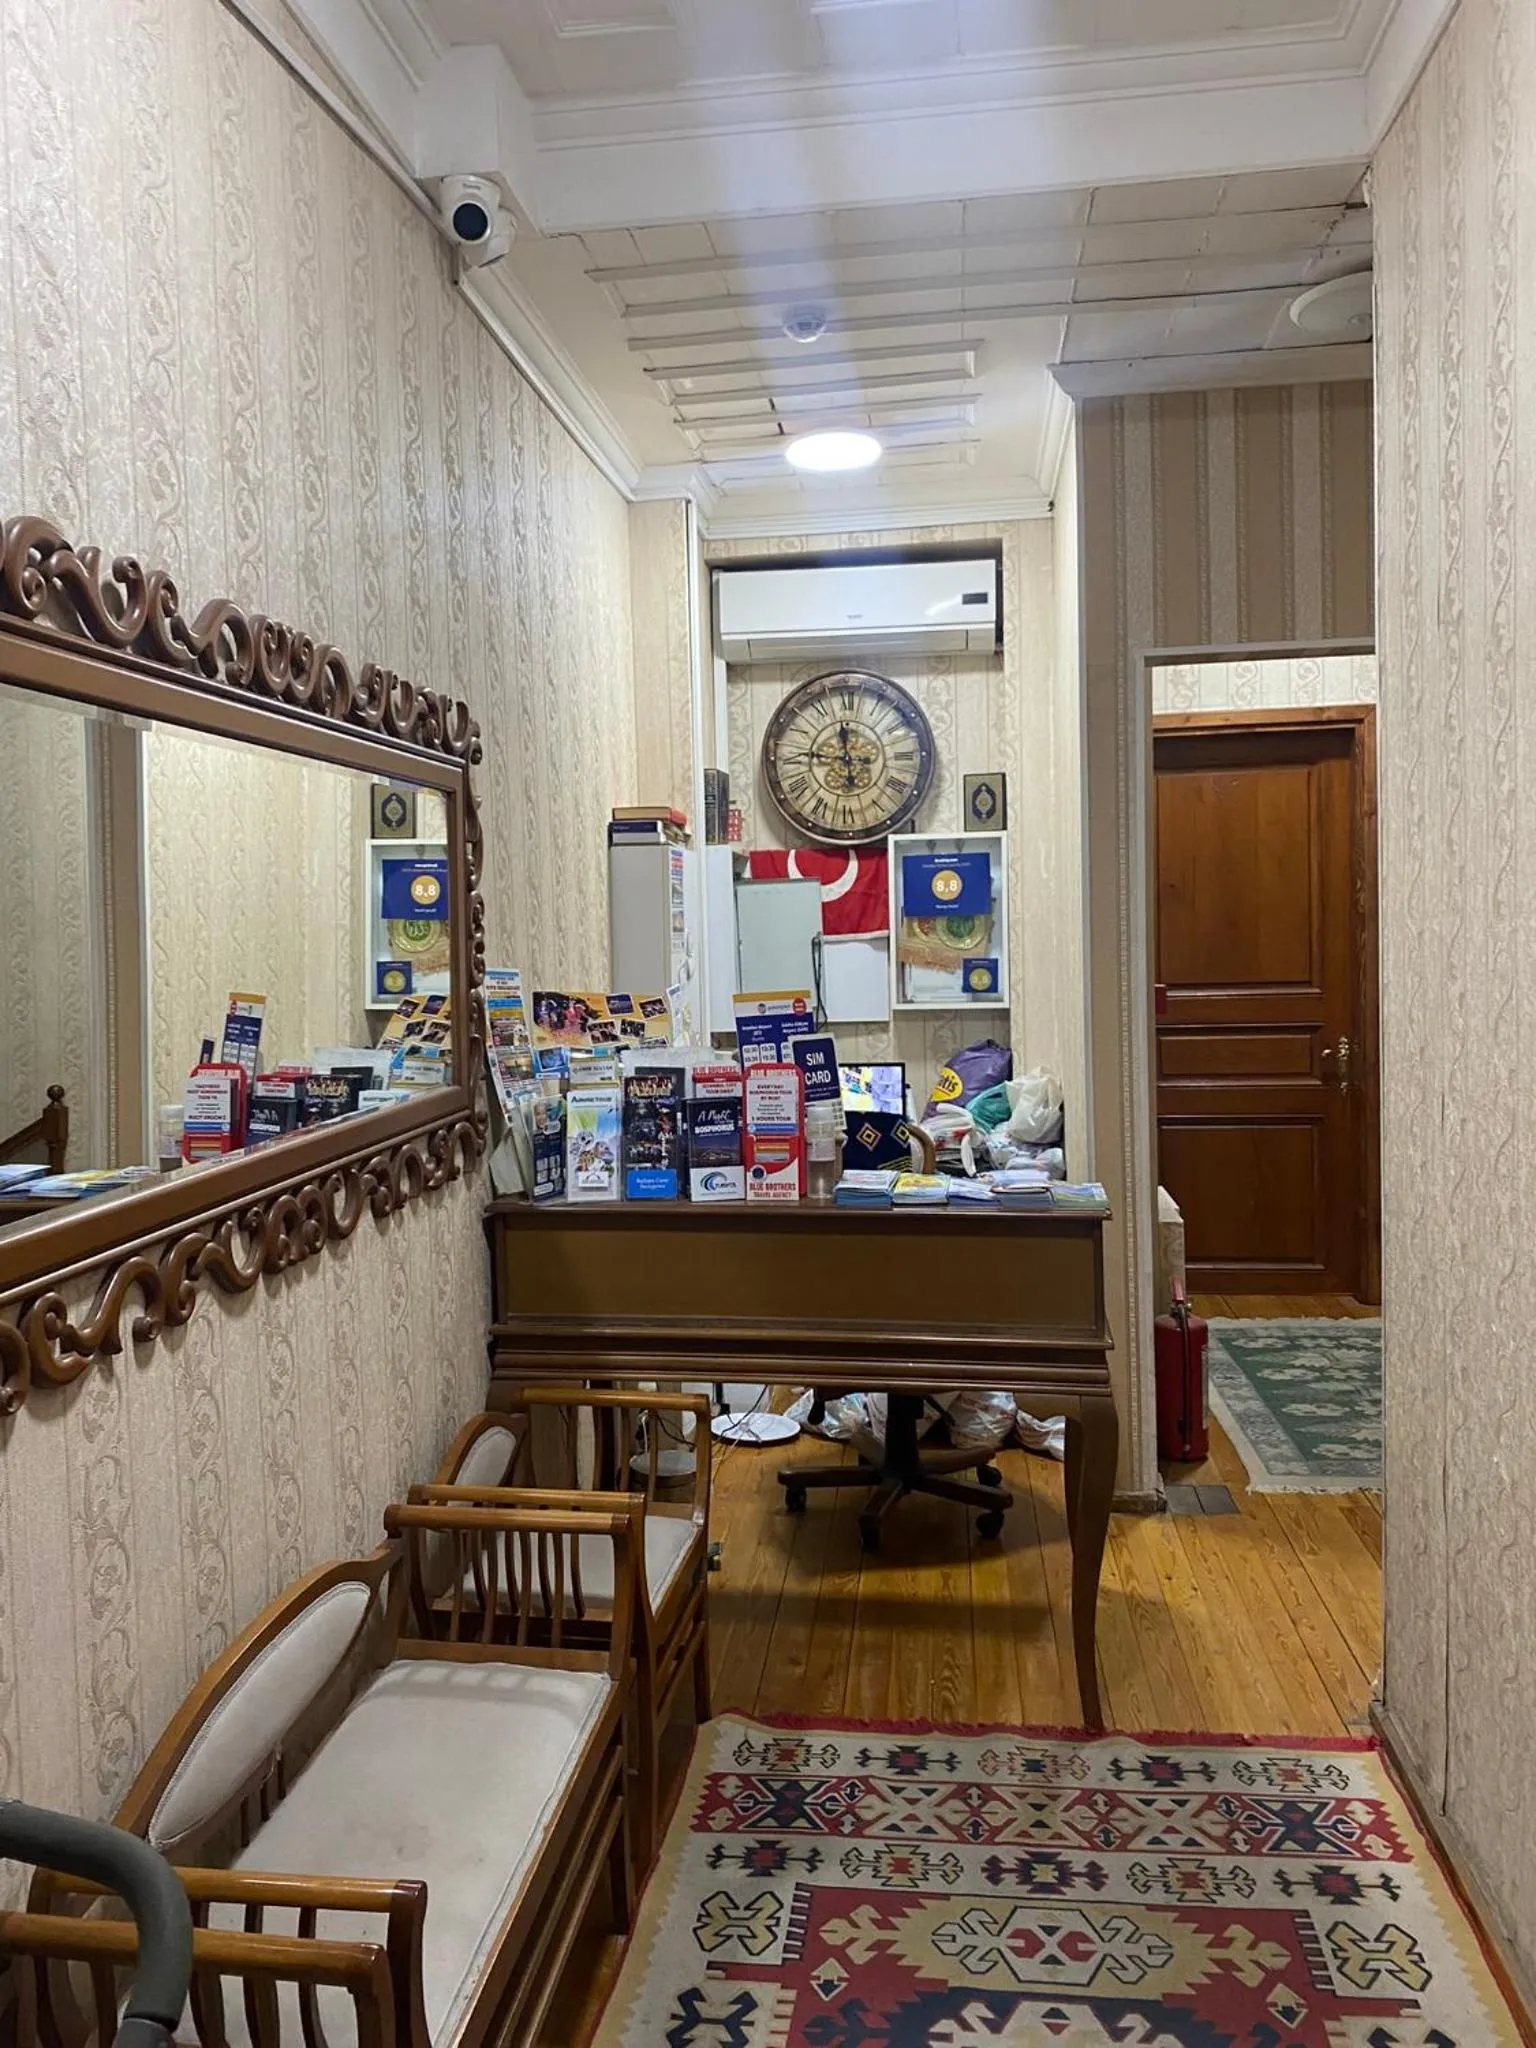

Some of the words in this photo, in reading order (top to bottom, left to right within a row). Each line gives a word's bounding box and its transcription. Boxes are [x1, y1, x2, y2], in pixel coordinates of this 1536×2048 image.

[806, 1052, 825, 1066] SIM
[805, 1070, 831, 1085] CARD
[694, 1124, 735, 1134] BOSPHORUS
[765, 1182, 797, 1191] BROTHERS
